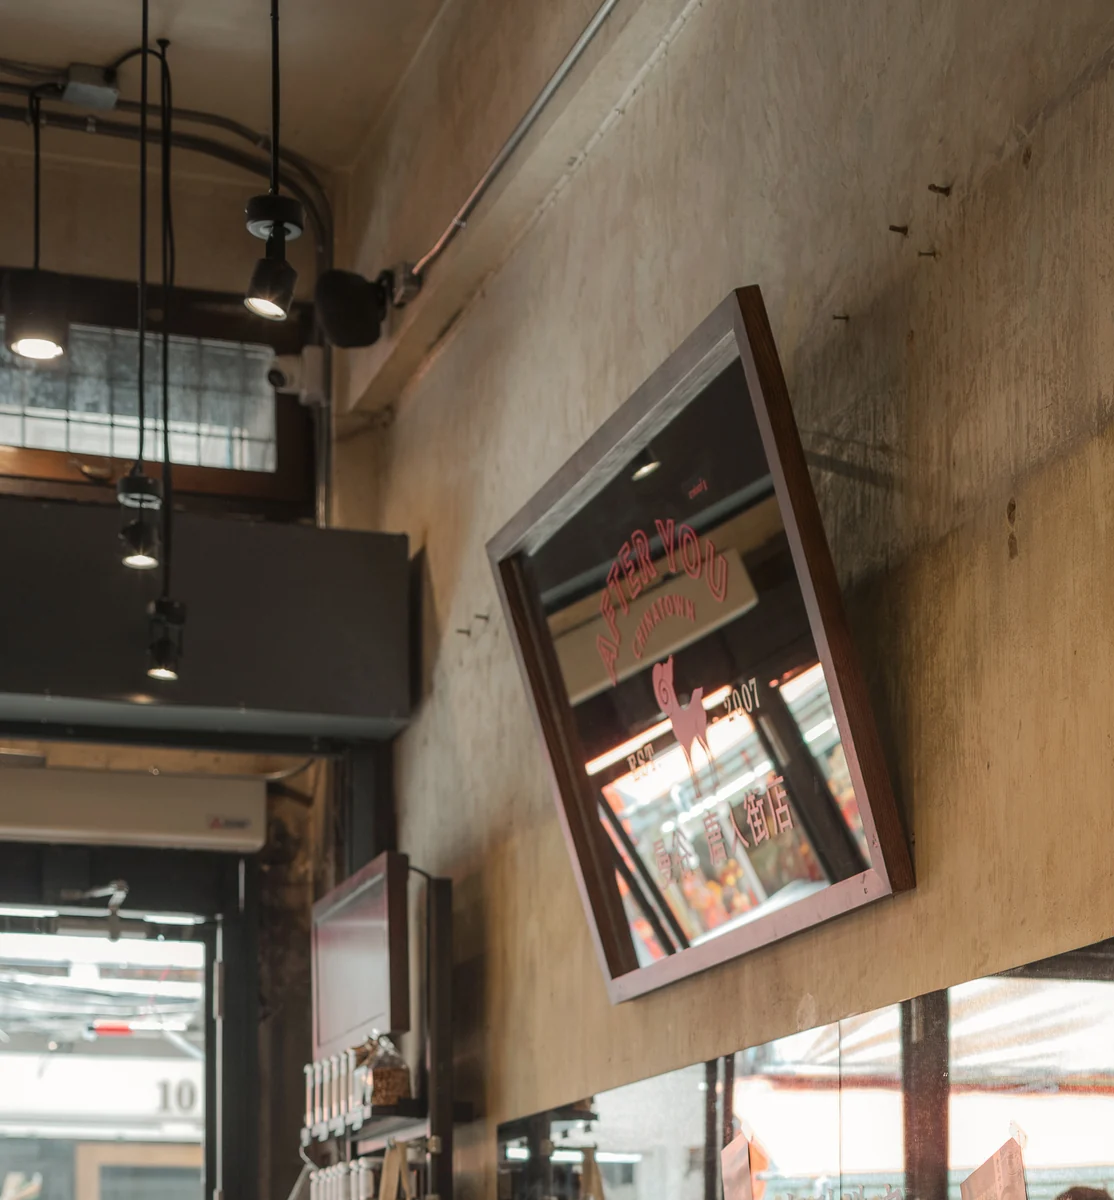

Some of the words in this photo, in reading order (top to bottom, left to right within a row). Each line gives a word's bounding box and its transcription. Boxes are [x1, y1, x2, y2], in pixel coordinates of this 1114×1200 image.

[597, 529, 657, 687] AFTER
[655, 519, 728, 603] YOU
[633, 594, 696, 660] CHINATOWN
[723, 677, 760, 722] 2007
[156, 1079, 198, 1114] 10
